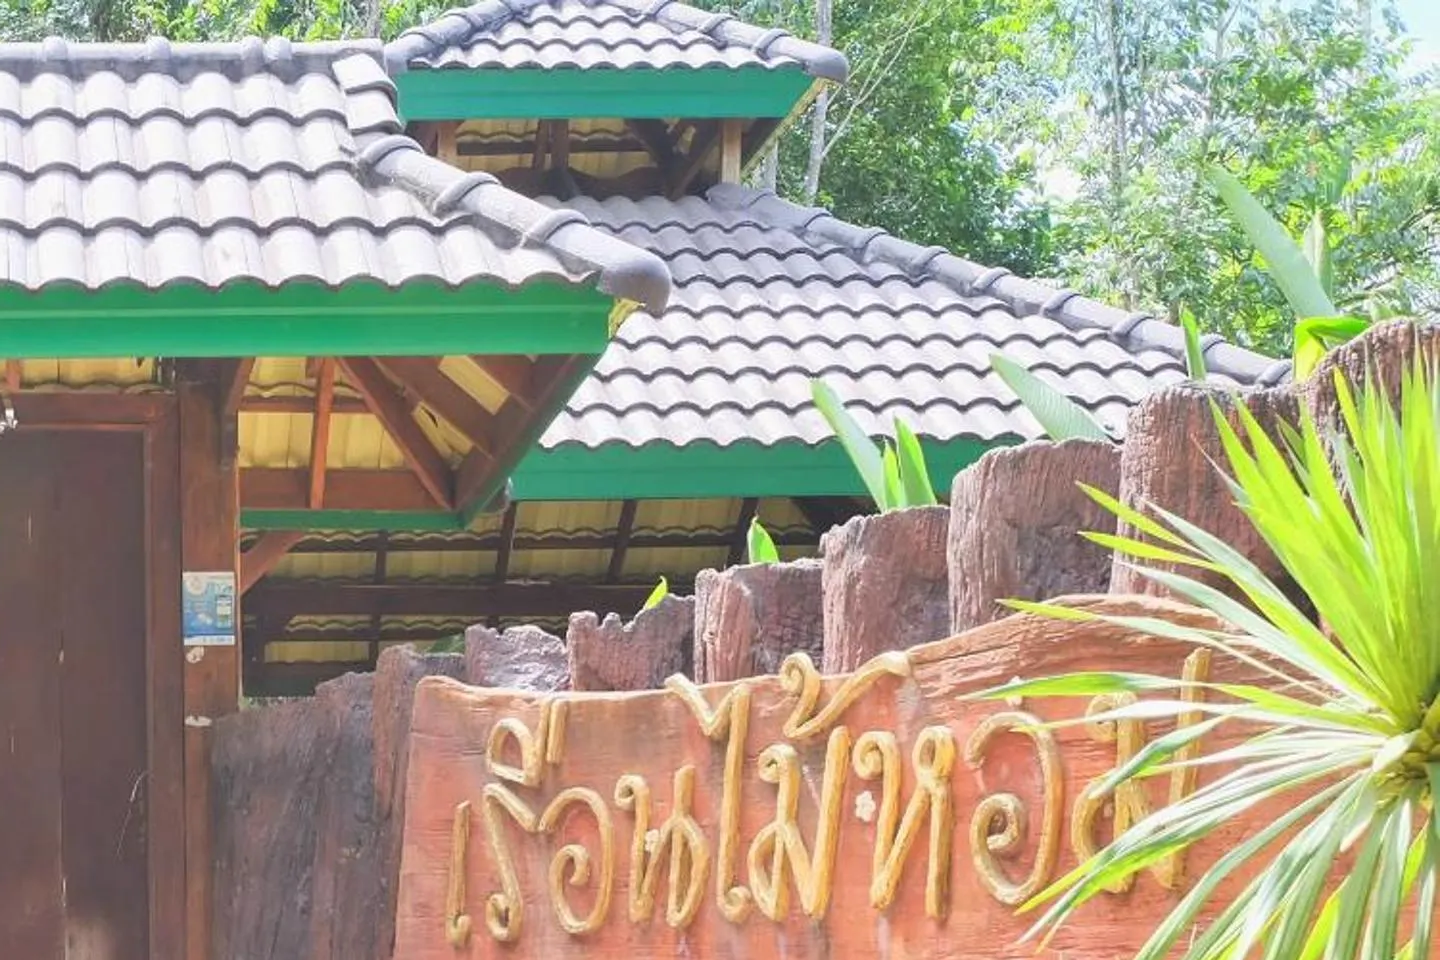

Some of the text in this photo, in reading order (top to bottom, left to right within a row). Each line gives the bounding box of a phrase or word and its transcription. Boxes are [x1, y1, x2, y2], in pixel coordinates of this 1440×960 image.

[445, 647, 1212, 948] เรือนไม้หอม
